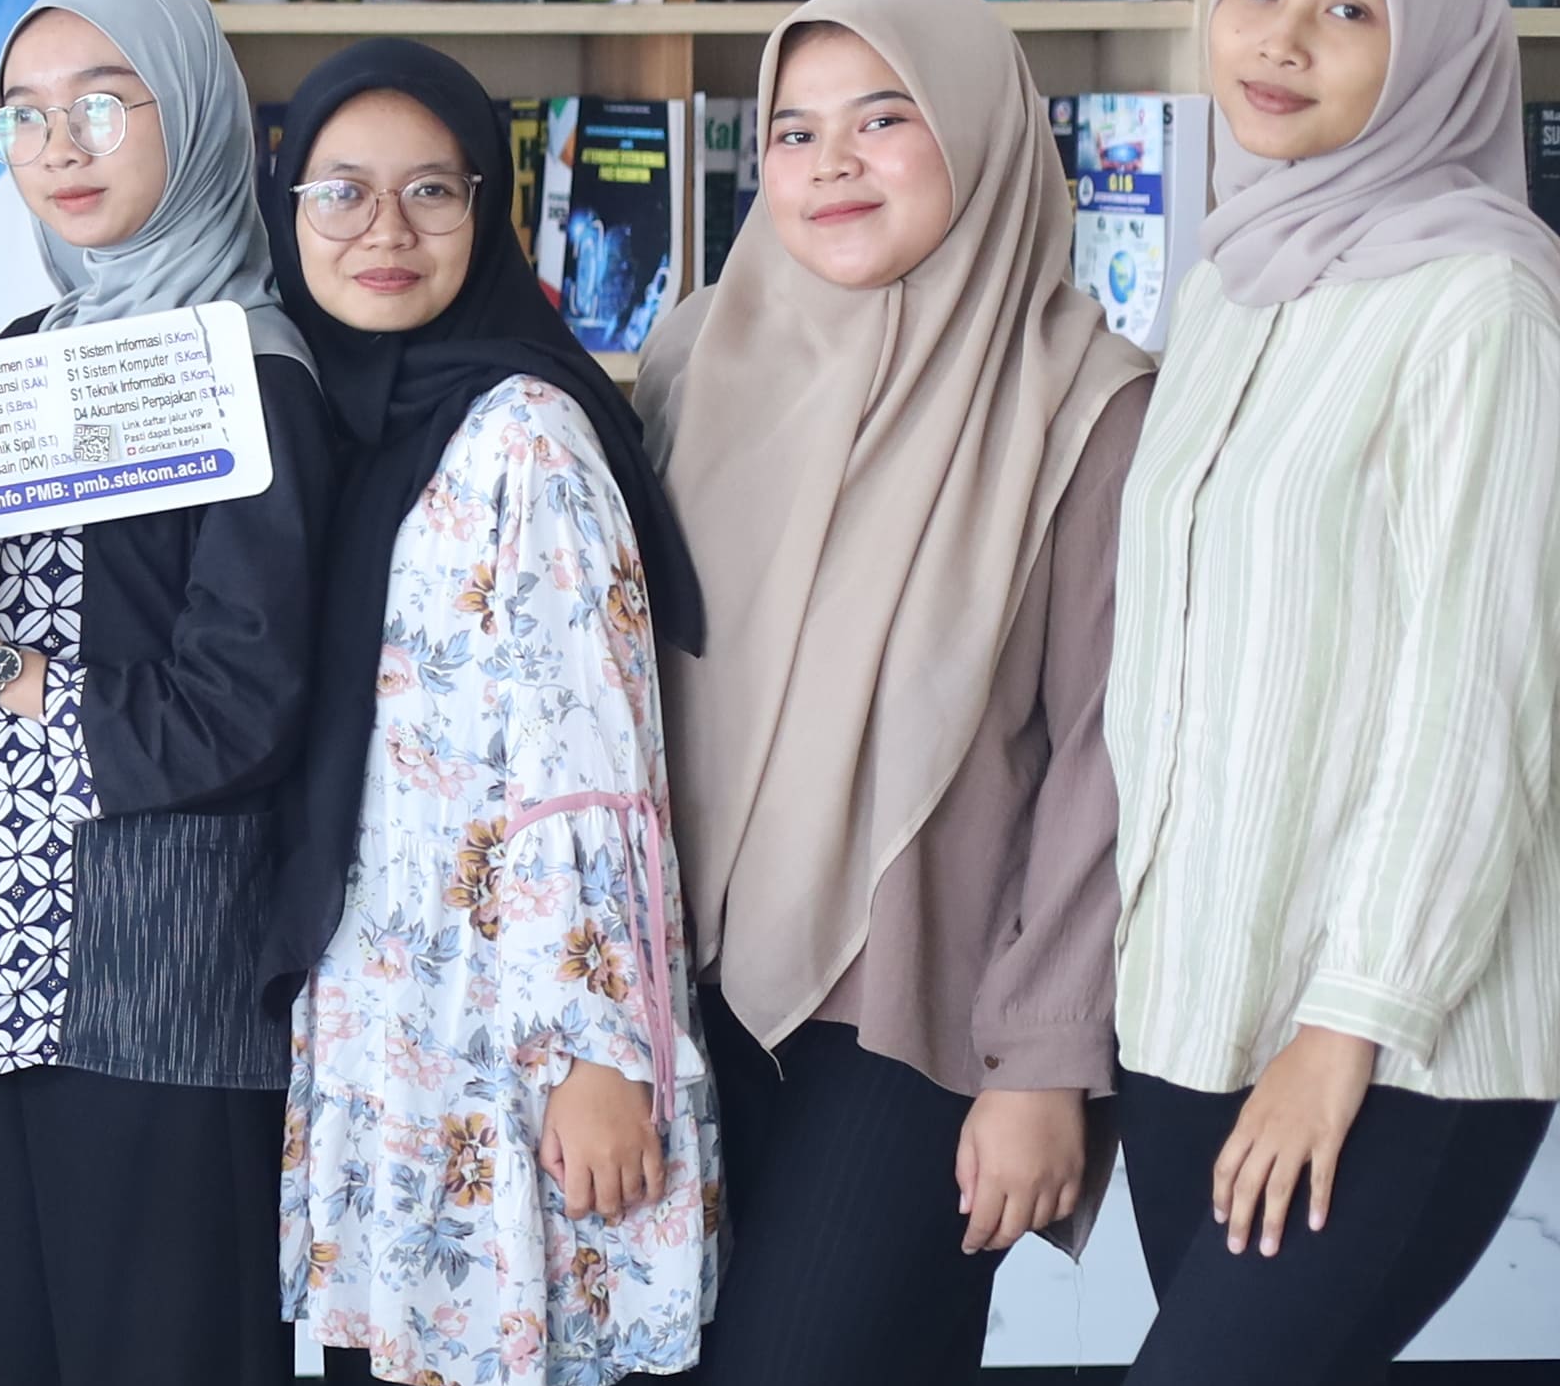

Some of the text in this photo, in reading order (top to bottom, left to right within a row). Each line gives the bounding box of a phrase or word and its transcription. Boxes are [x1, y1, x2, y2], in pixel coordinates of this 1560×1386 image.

[79, 344, 114, 361] Sistem
[116, 334, 162, 355] Informasi
[164, 328, 199, 346] (S.Kom.)
[83, 362, 117, 380] Sistem
[119, 353, 169, 375] Komputer
[86, 382, 119, 399] Teknik
[121, 372, 176, 393] Informatika
[73, 389, 197, 422] D4 Akuntansi Perpajakan
[122, 421, 140, 430] Link
[142, 415, 167, 427] daftar
[169, 412, 187, 426] jalur
[148, 427, 171, 441] dapat
[173, 421, 212, 435] beasiswa
[13, 435, 36, 456] Sipil
[179, 436, 200, 450] kerja
[19, 453, 49, 474] (DKV)
[25, 481, 71, 504] PMB:
[73, 453, 218, 499] pmb.stekom.ac.id
